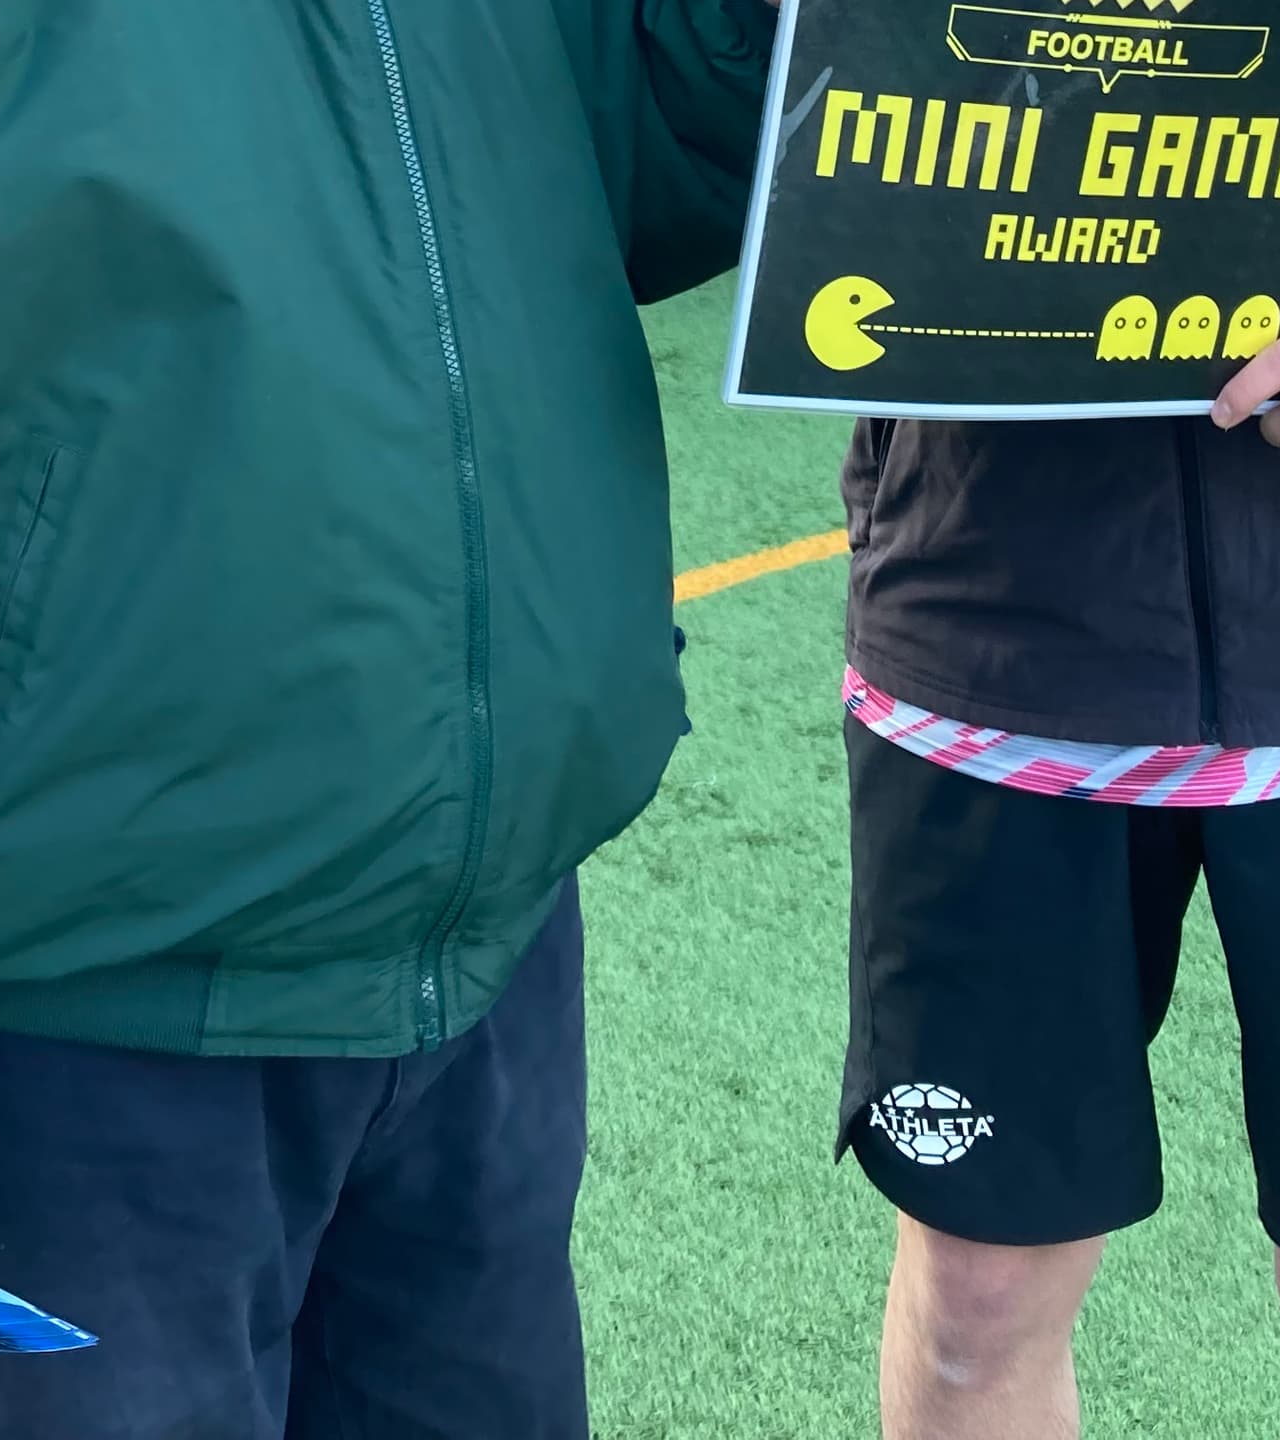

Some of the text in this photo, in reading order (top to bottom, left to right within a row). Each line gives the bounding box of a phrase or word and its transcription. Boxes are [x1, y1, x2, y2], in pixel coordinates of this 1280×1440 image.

[1028, 29, 1188, 66] FOOTBALL
[816, 90, 1042, 192] MINI
[985, 214, 1161, 263] AWARD
